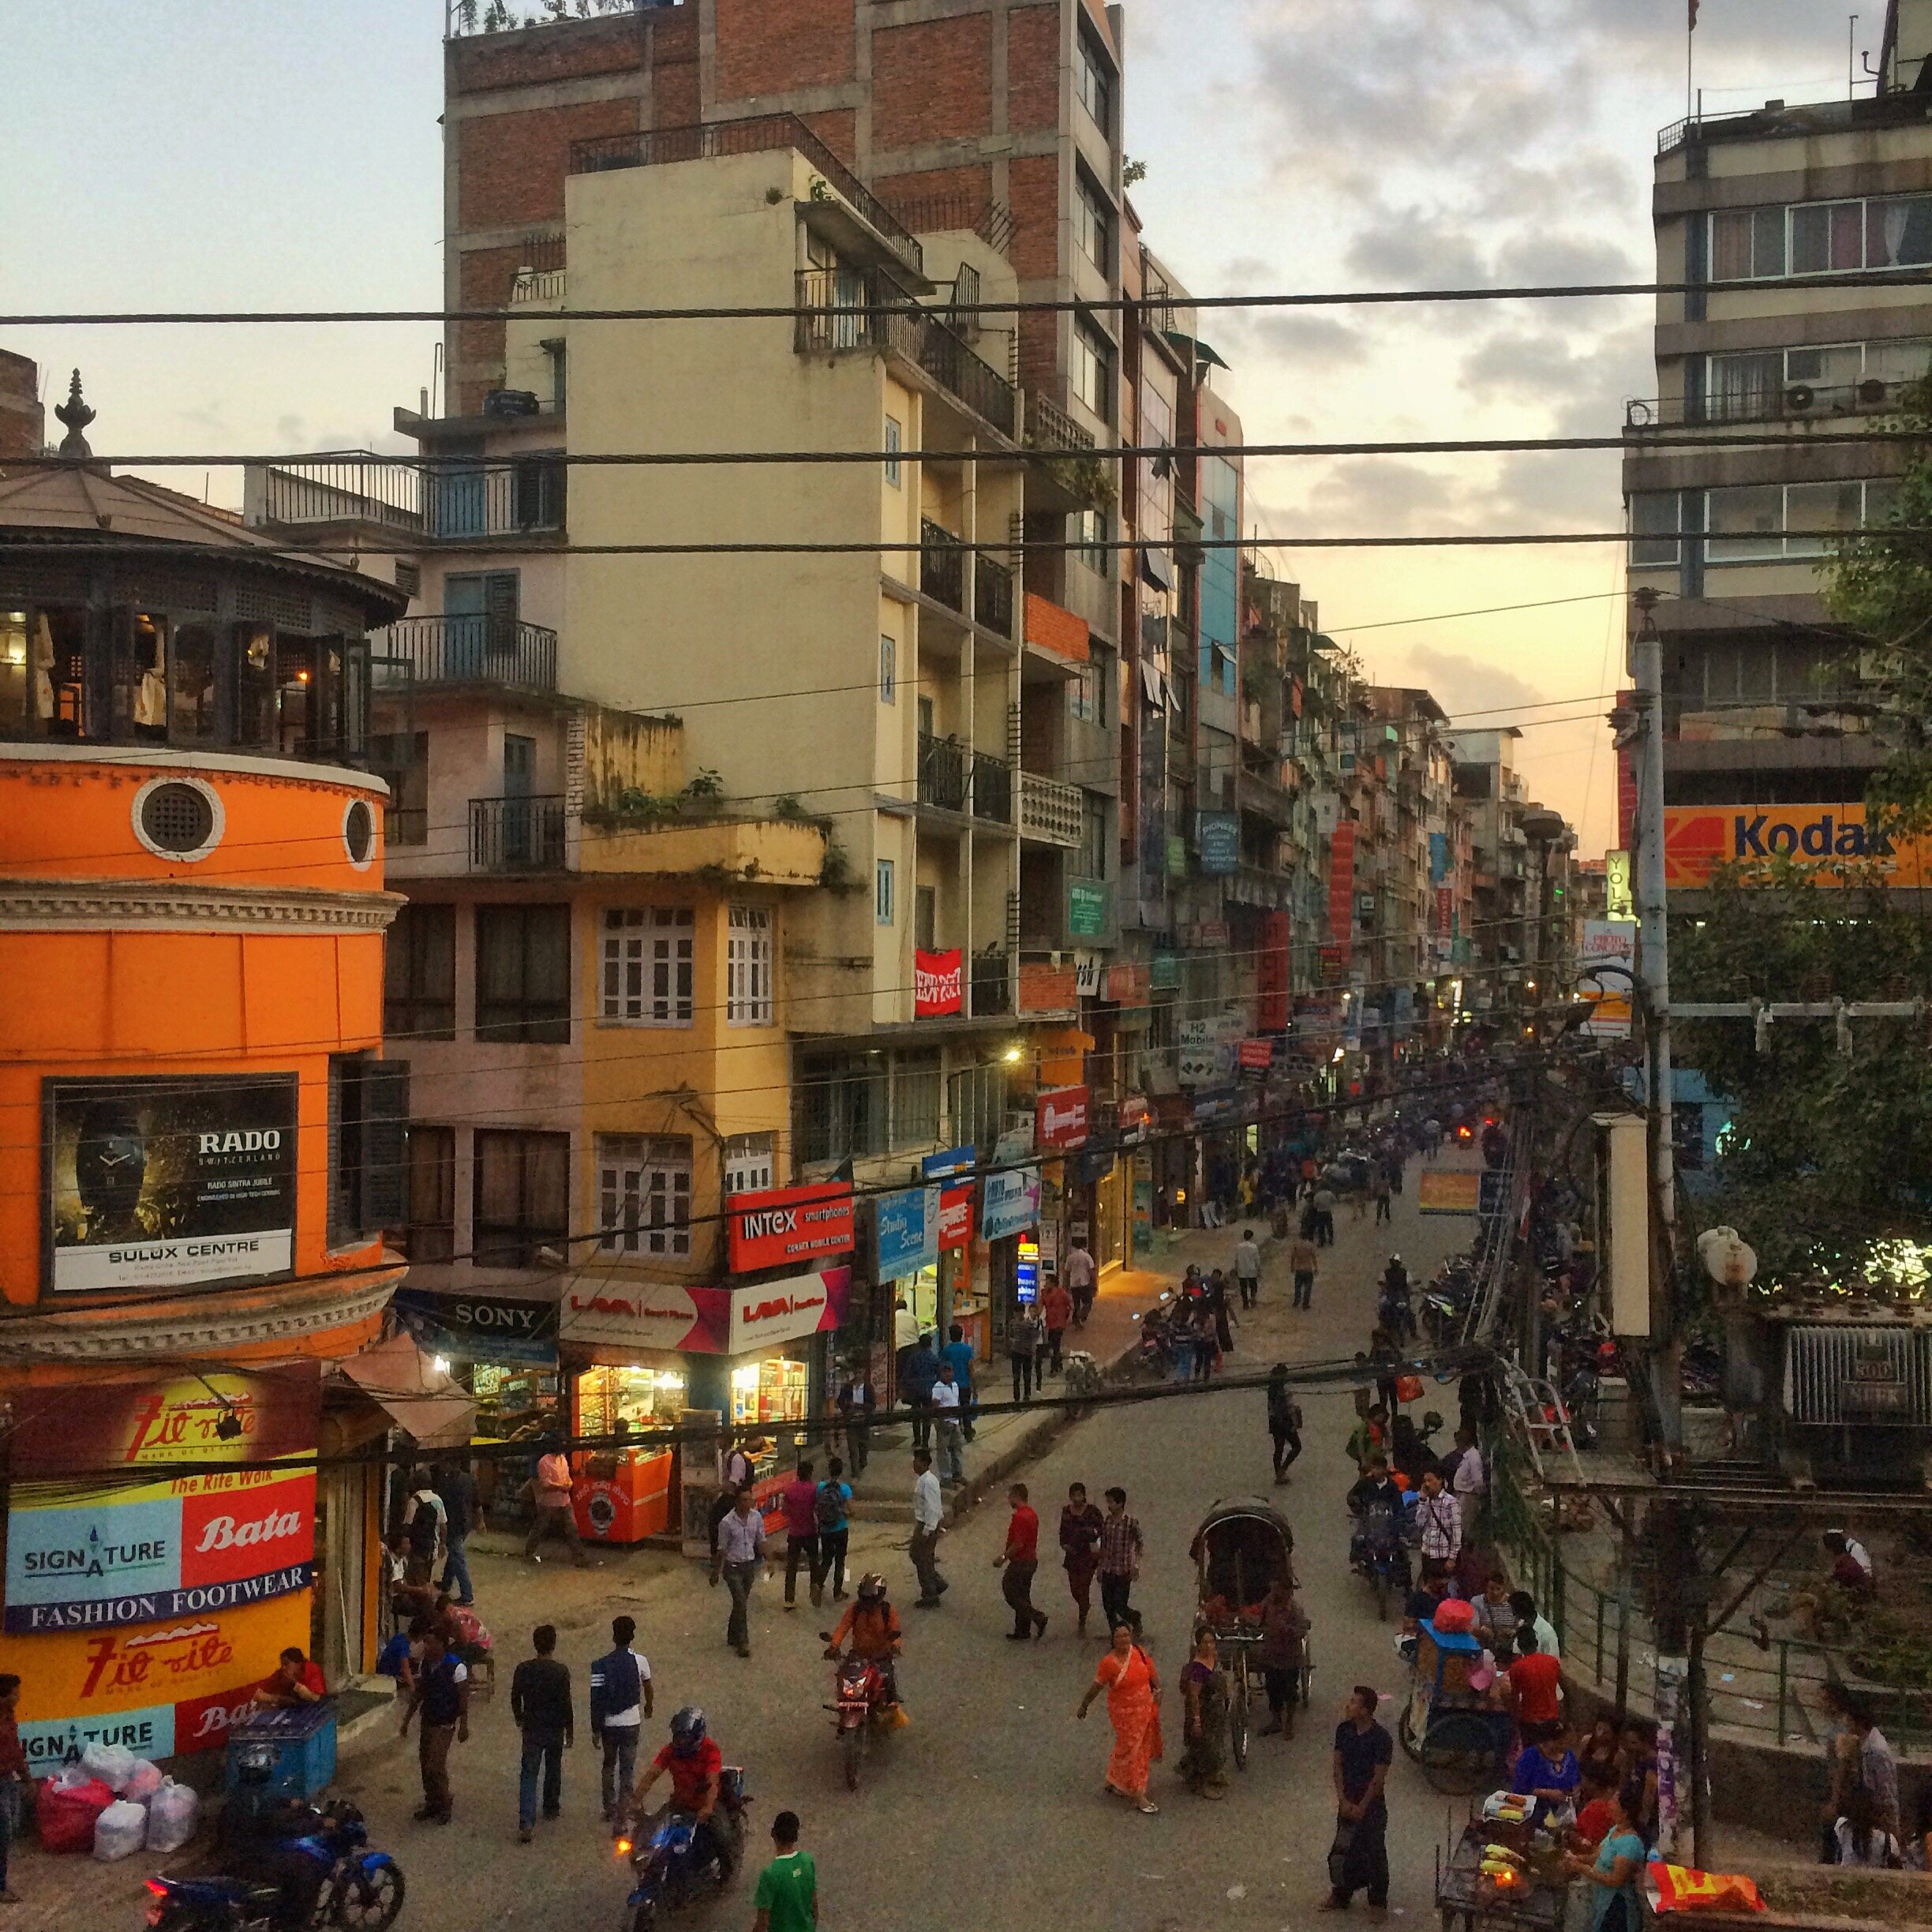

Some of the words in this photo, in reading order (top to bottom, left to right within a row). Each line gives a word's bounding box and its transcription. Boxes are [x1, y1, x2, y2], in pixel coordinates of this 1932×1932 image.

[1190, 1023, 1206, 1033] H2
[199, 1130, 280, 1154] RADO
[199, 1152, 280, 1166] SWITZERLAND
[805, 1206, 849, 1222] smartphones
[109, 1247, 178, 1264] SULUX
[187, 1240, 260, 1256] CENTRE
[455, 1303, 536, 1328] SONY
[170, 1477, 198, 1494] The
[204, 1473, 233, 1490] Rite
[239, 1469, 273, 1486] Walk
[196, 1508, 301, 1552] Bata
[24, 1541, 166, 1578] SIGNATURE
[31, 1596, 156, 1627] FASHION
[172, 1567, 304, 1613] FOOTWEAR
[23, 1721, 152, 1765] IGNATURE
